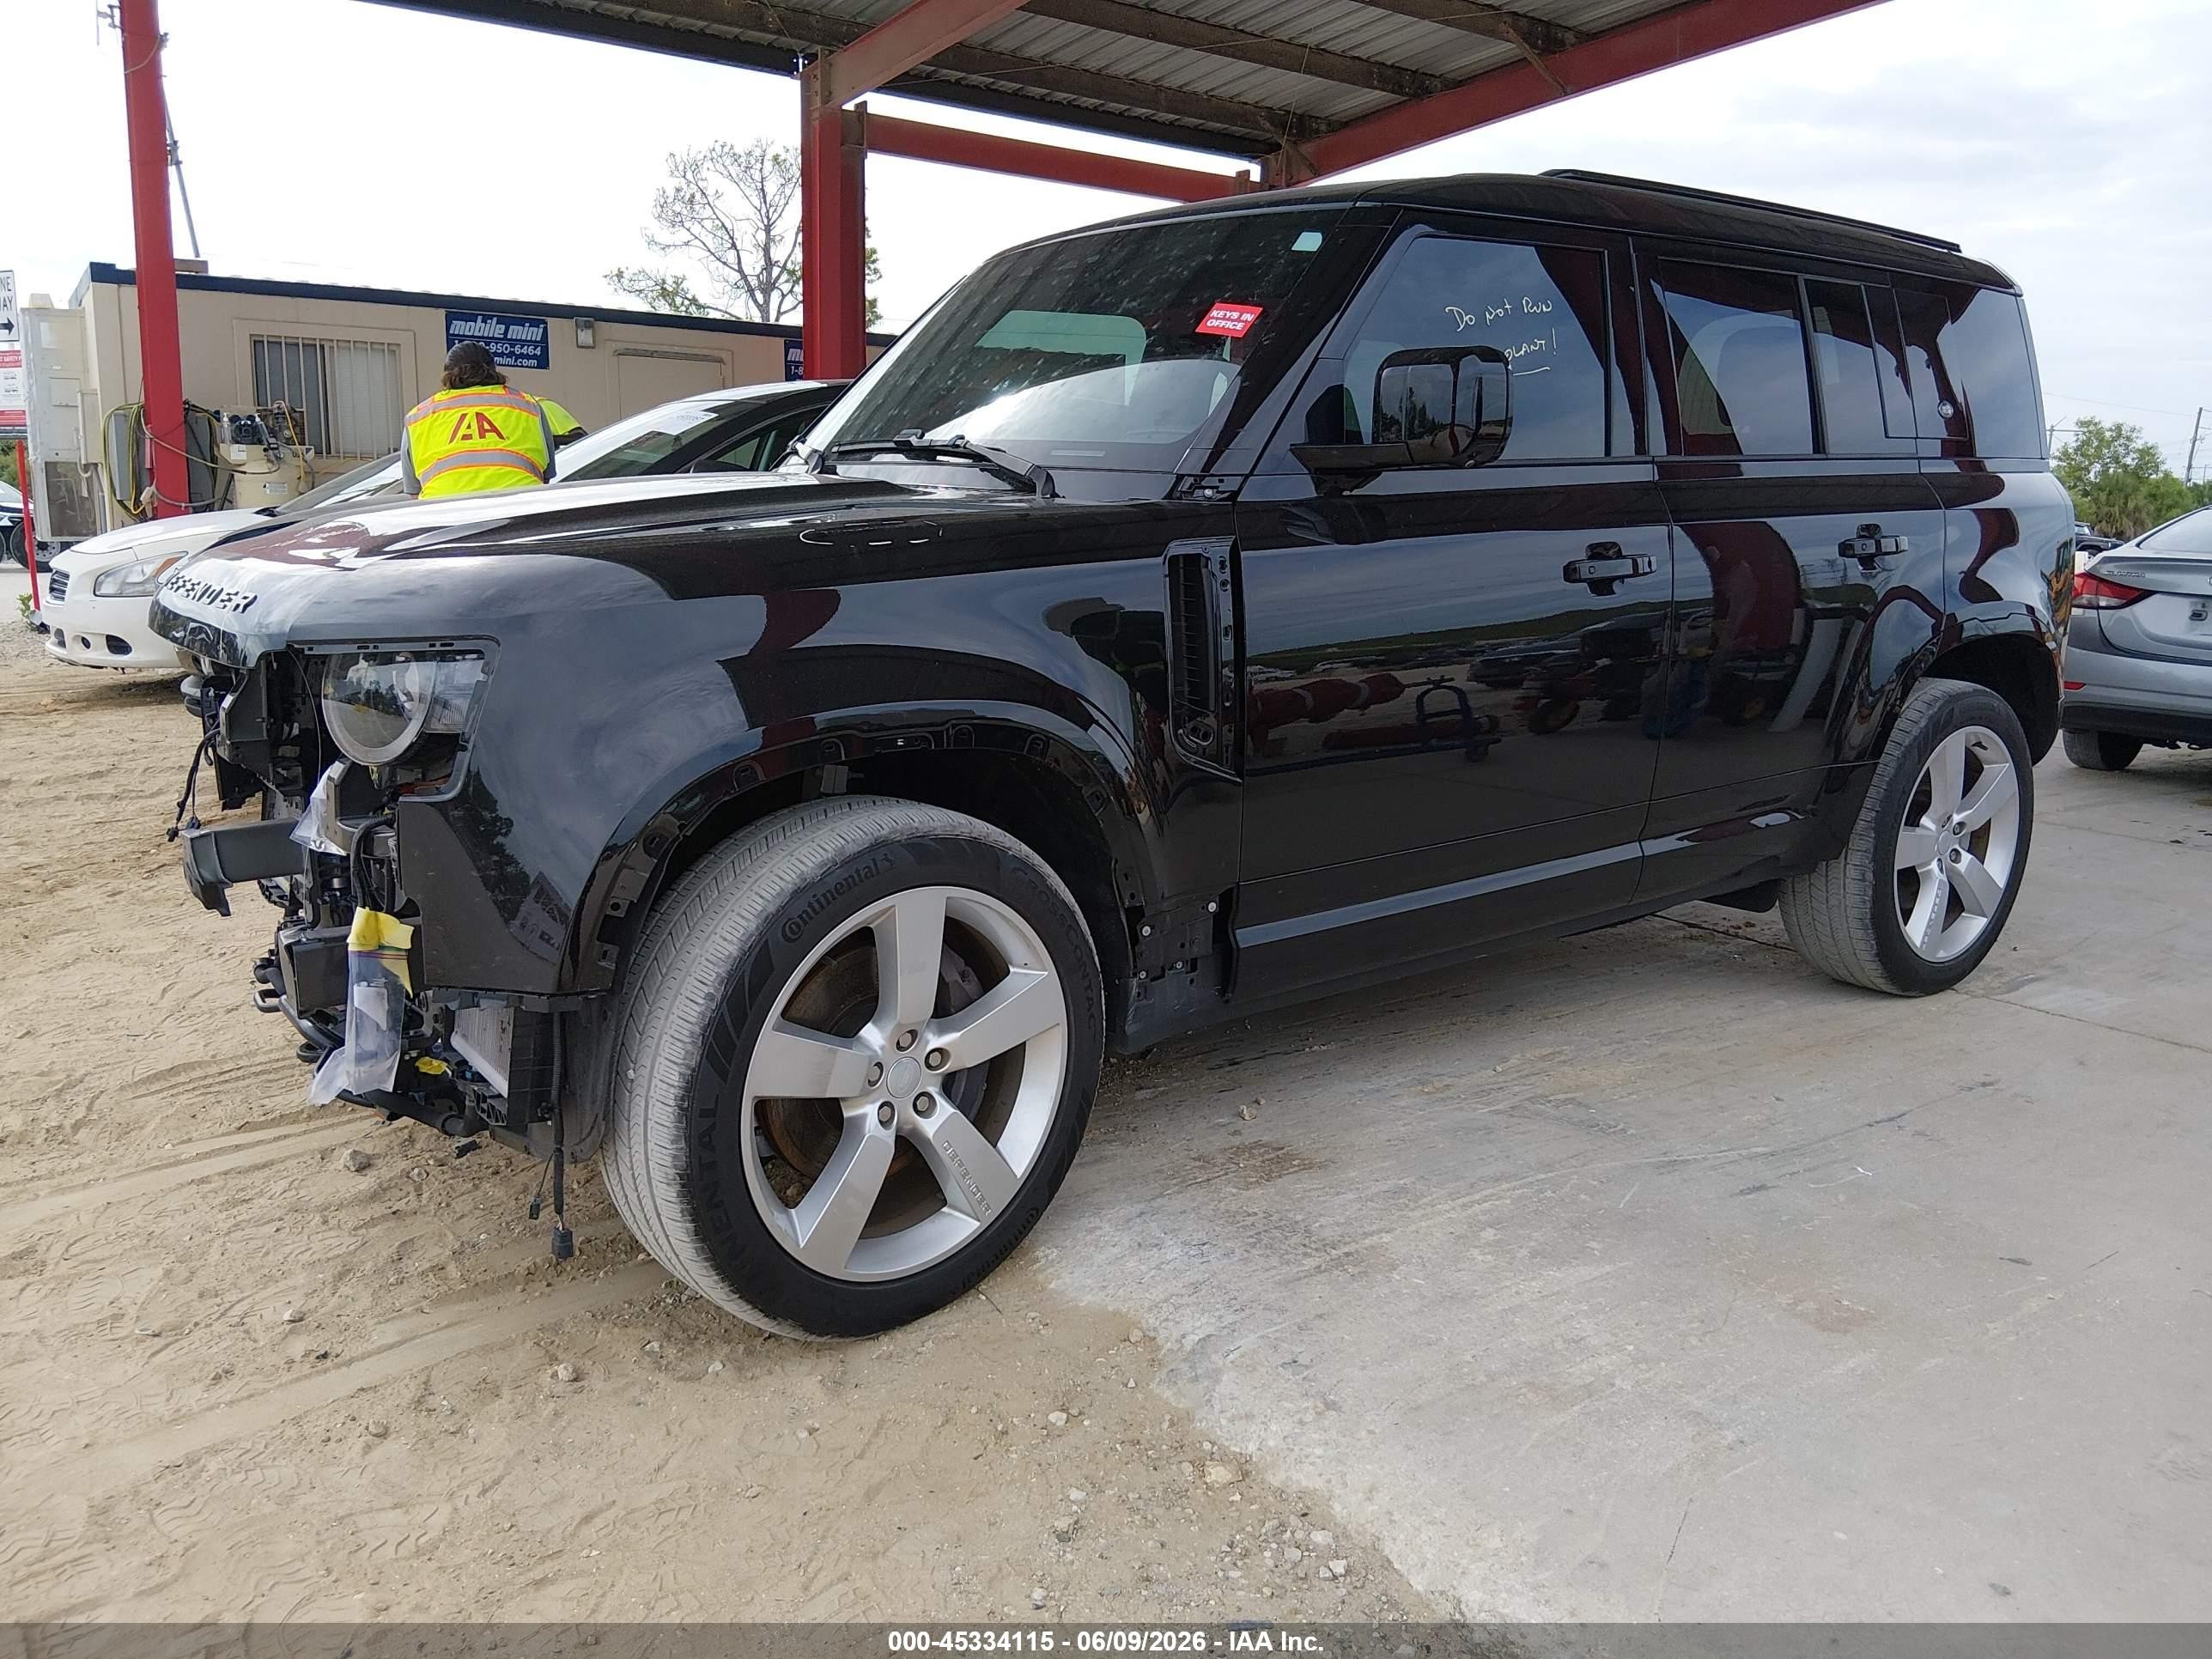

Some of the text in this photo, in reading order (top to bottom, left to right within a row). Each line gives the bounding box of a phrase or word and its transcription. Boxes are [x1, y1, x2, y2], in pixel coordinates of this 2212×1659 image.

[0, 276, 12, 292] NE
[0, 295, 13, 311] AY
[1210, 309, 1255, 321] KEYS IN
[1445, 306, 1475, 331] Do
[449, 315, 544, 342] mobile mini
[1206, 319, 1245, 331] OFFICE
[495, 355, 538, 367] mini.com
[165, 574, 258, 614] EFENDER
[942, 1140, 992, 1216] DEFENDER
